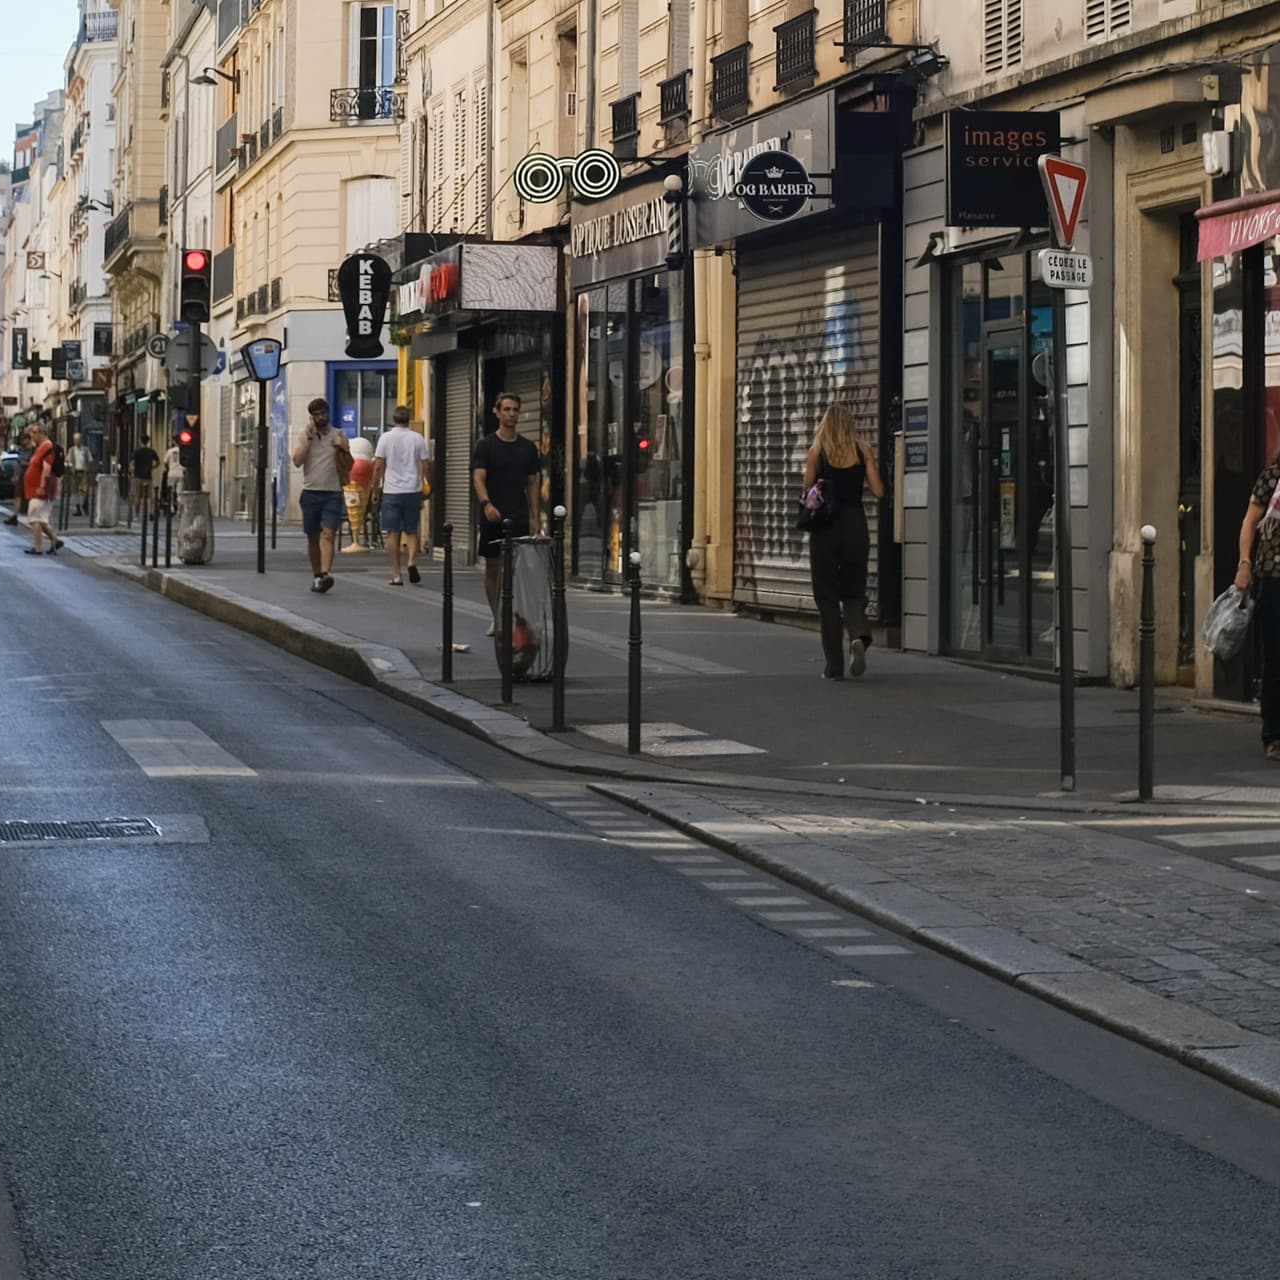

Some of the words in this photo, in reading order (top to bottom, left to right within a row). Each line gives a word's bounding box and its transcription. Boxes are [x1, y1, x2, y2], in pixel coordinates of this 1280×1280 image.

[964, 125, 1047, 151] images
[965, 154, 1034, 168] servic
[735, 183, 756, 196] OG
[759, 183, 814, 196] BARBER
[571, 214, 610, 260] OPTIQUE
[613, 196, 668, 246] LOSSERAN
[1229, 209, 1276, 246] VIVONS
[1048, 256, 1074, 268] CÉDEZ
[1077, 258, 1087, 269] LE
[1050, 270, 1086, 282] PASSAGE
[358, 260, 374, 335] KEBAB
[154, 341, 166, 351] 21
